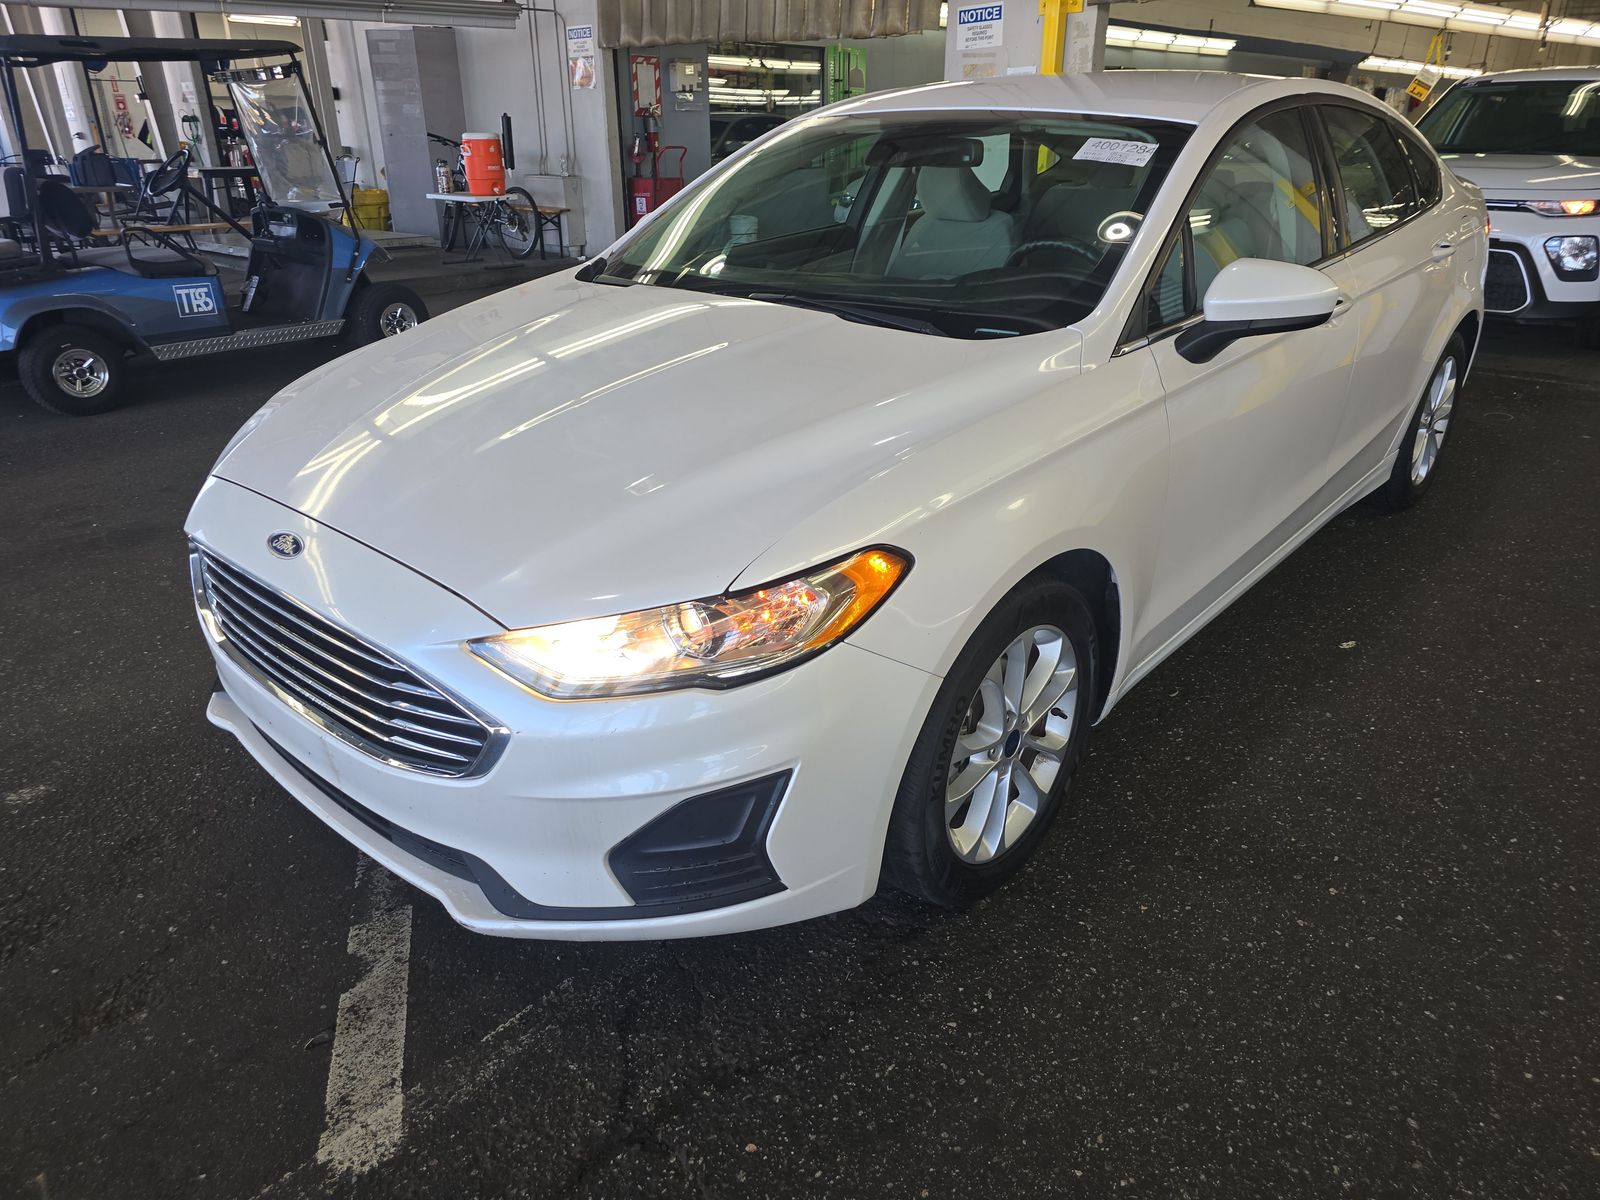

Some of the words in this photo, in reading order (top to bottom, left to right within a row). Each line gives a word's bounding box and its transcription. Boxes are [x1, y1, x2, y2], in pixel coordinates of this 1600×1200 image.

[960, 7, 1000, 23] NOTICE
[568, 28, 591, 39] NOTICE
[930, 695, 967, 802] KUMHO
